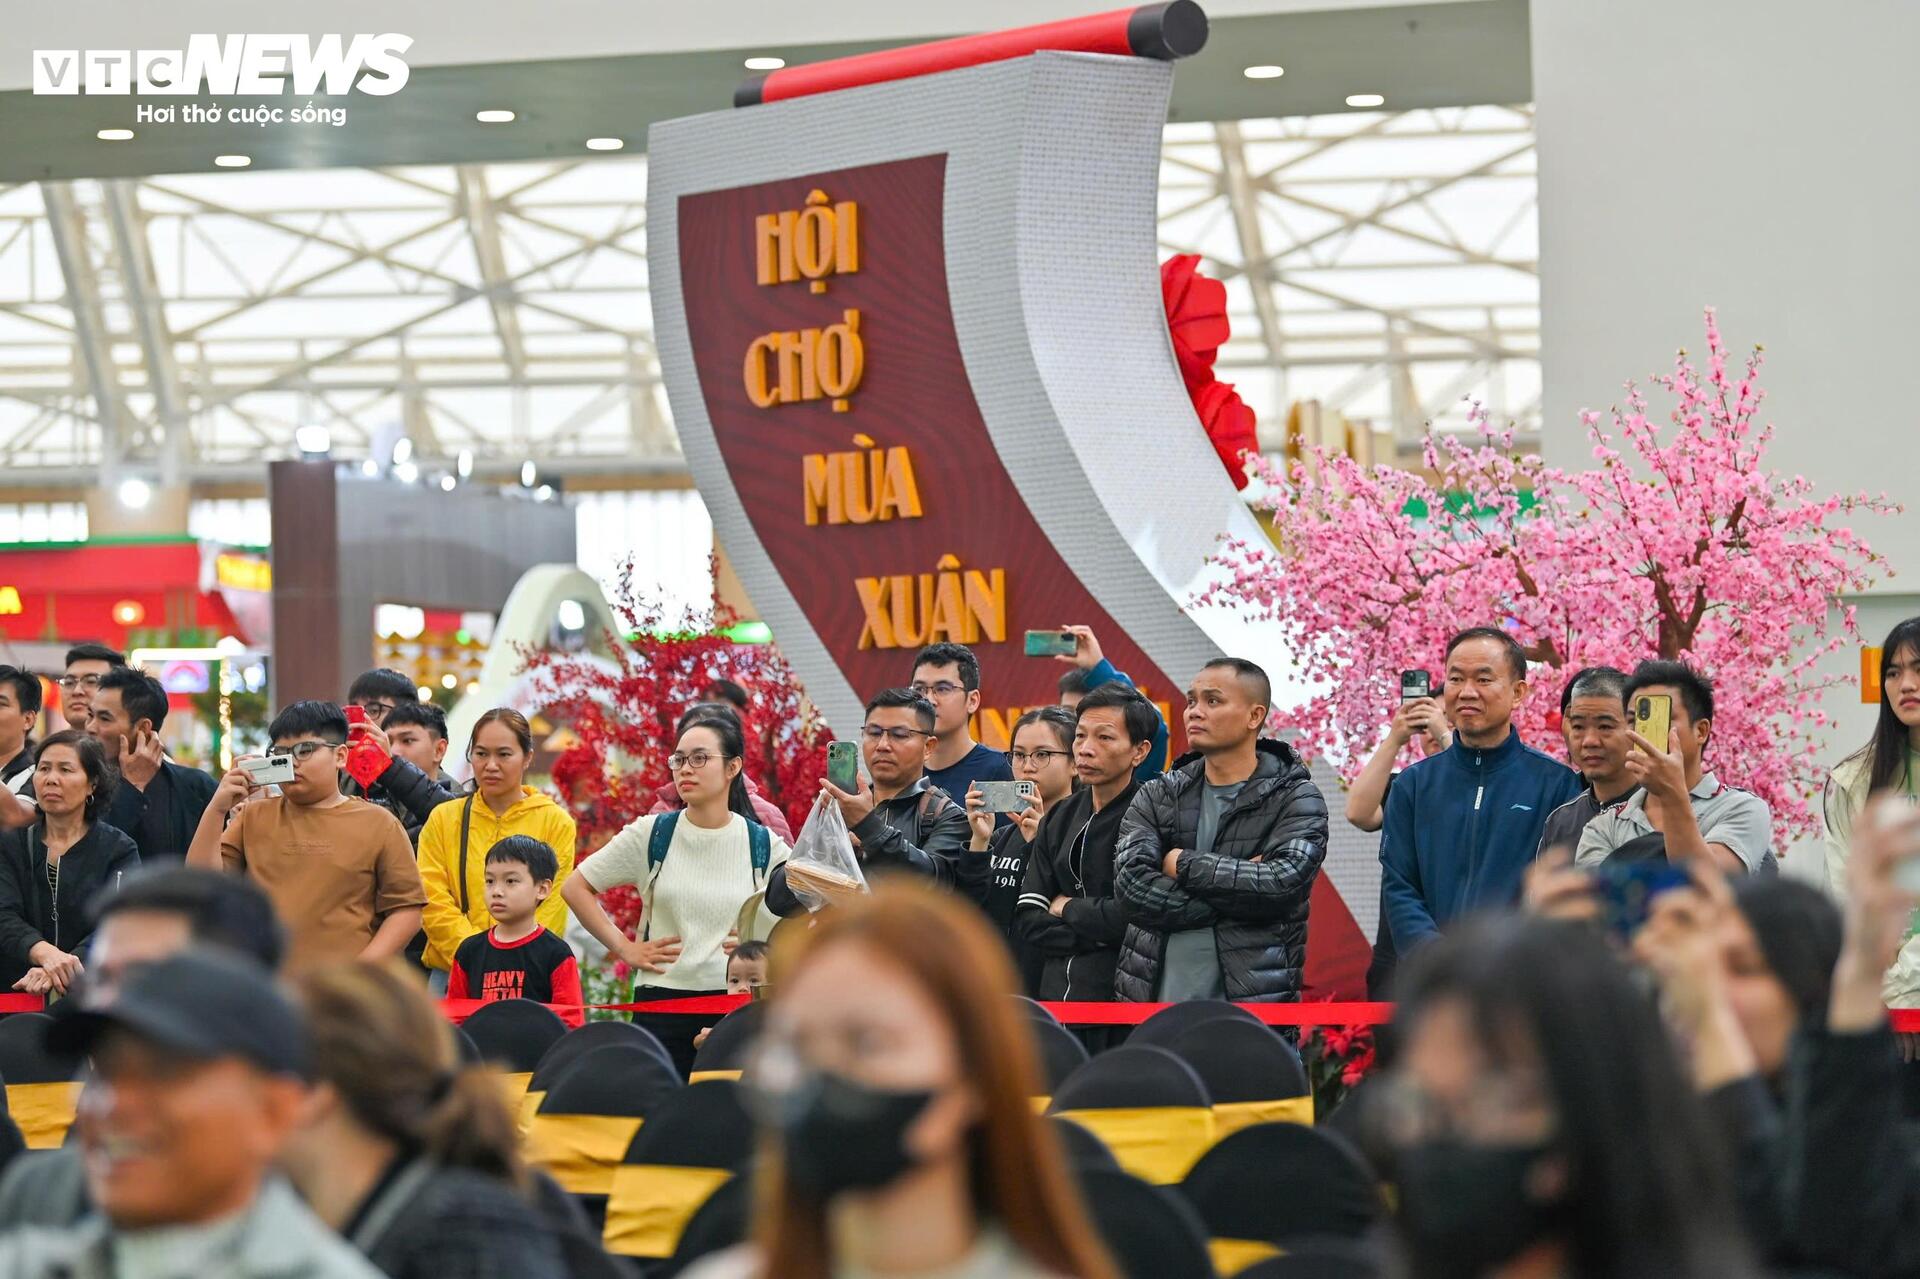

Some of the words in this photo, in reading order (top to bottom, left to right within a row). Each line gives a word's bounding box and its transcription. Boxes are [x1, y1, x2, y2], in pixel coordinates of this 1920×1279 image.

[756, 189, 858, 293] HỘI
[743, 308, 864, 412] CHỢ
[803, 433, 923, 525] MÙA
[855, 554, 1007, 650] XUÂN
[483, 970, 525, 988] HEAVY
